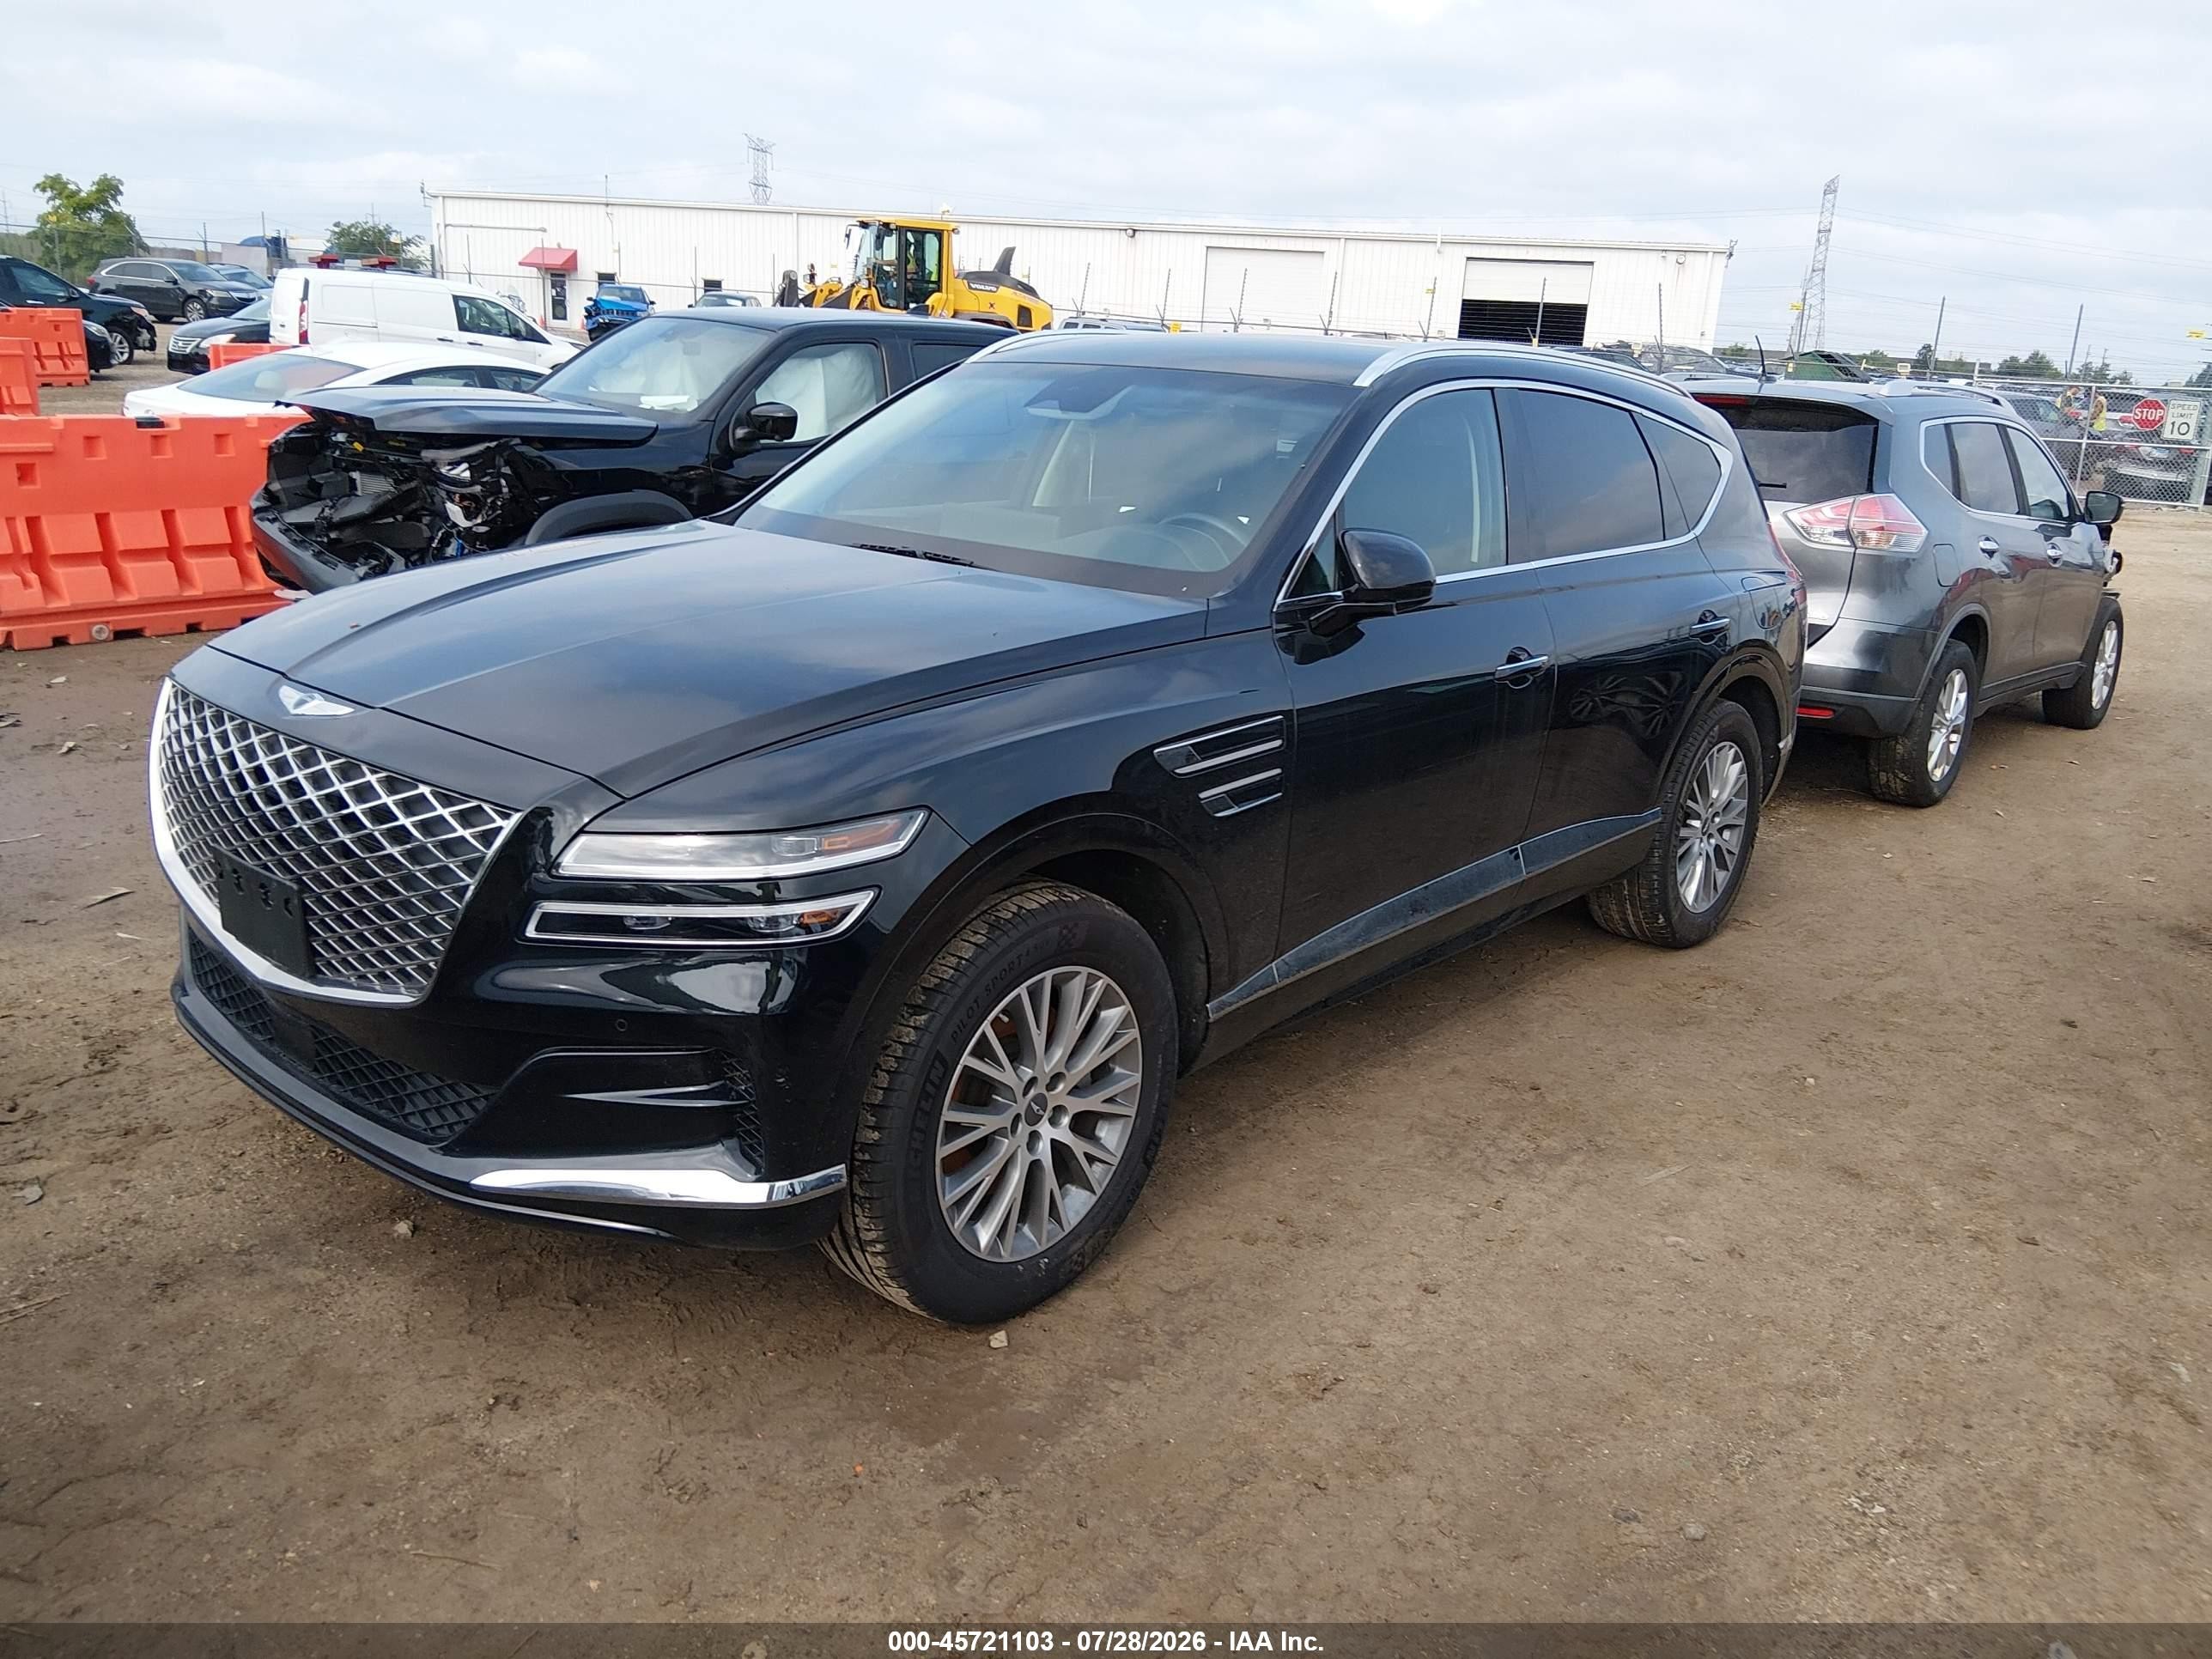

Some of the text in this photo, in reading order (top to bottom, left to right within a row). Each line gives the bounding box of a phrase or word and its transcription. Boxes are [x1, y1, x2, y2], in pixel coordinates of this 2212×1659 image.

[2134, 408, 2164, 421] STOP
[2171, 421, 2191, 436] 10
[951, 954, 1022, 1042] PILOT SPORT
